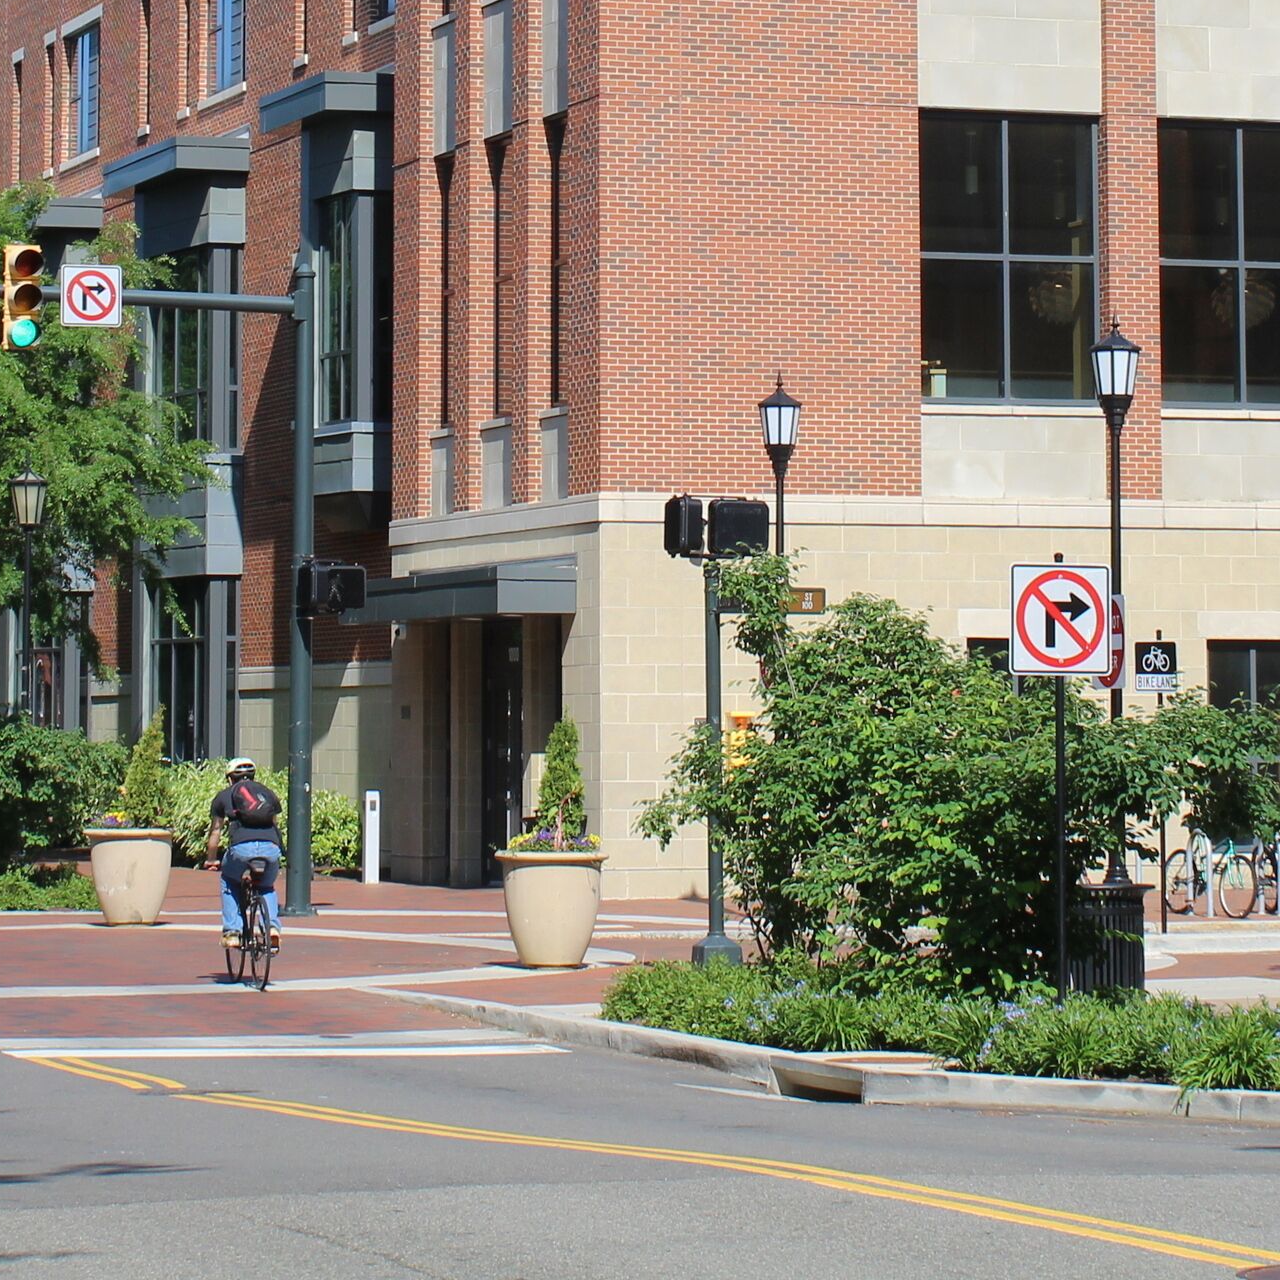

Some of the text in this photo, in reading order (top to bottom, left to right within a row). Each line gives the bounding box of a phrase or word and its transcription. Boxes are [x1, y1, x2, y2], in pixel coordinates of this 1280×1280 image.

[804, 592, 813, 601] ST
[801, 601, 814, 610] 100
[1137, 676, 1156, 688] BIKE
